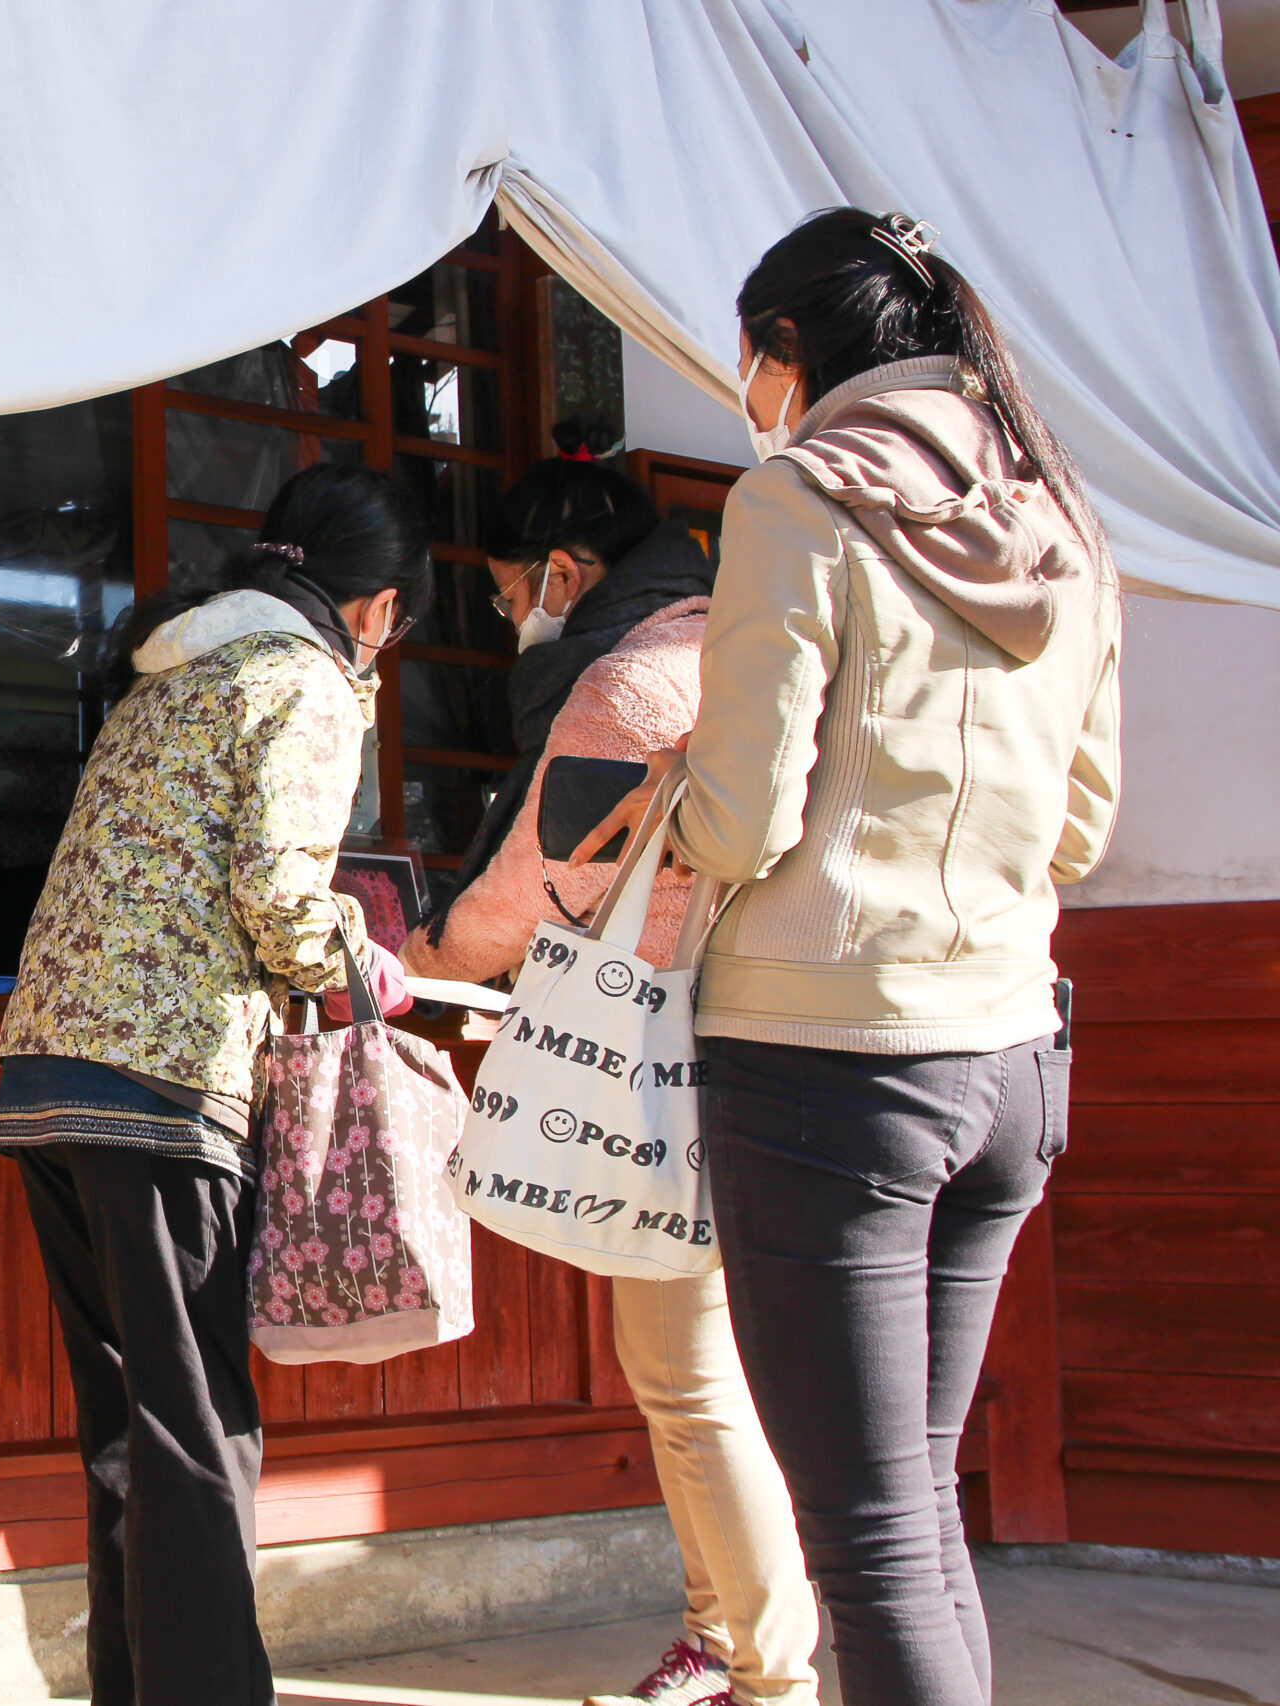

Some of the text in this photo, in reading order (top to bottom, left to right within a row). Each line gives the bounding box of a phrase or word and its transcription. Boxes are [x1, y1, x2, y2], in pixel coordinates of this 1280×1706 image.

[535, 1025, 627, 1079] MBE
[487, 1173, 571, 1214] MBE
[632, 1210, 712, 1246] MBE
